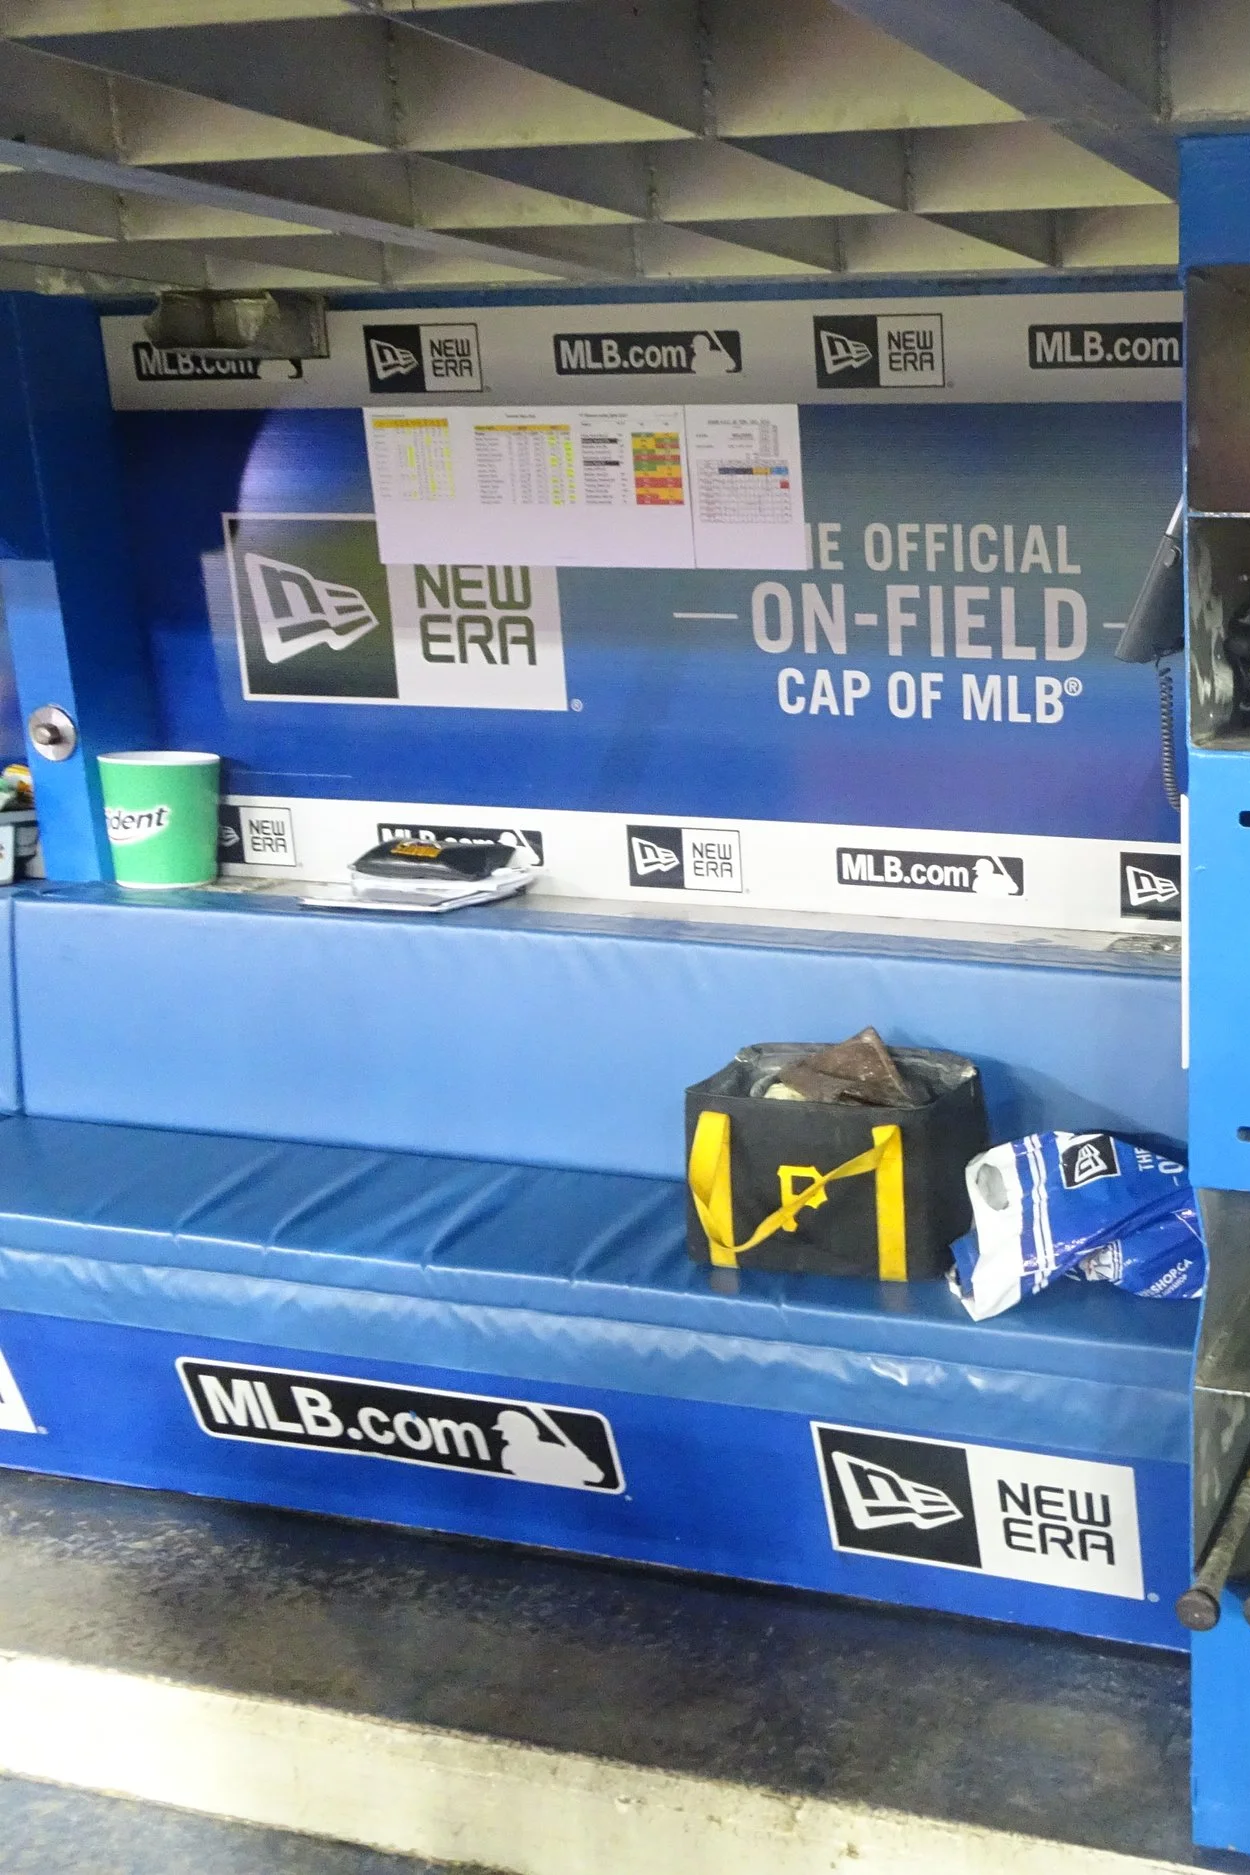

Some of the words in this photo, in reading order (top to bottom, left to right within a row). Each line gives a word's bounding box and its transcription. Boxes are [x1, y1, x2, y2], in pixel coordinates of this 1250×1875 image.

[429, 338, 471, 358] NEW
[559, 339, 688, 370] MLB.com
[887, 330, 933, 350] NEW
[1035, 330, 1180, 363] MLB.com
[432, 359, 473, 377] ERA
[889, 352, 934, 371] ERA
[864, 522, 1082, 574] OFFICIAL
[414, 564, 532, 611] NEW
[751, 580, 1088, 662] ON-FIELD
[419, 614, 537, 666] ERA
[777, 666, 871, 717] CAP
[887, 670, 944, 719] OF
[248, 819, 285, 836] NEW
[251, 837, 288, 853] ERA
[692, 842, 732, 860] NEW
[693, 860, 733, 878] ERA
[842, 853, 970, 887] MLB.com
[199, 1374, 491, 1461] MLB.com
[997, 1479, 1111, 1527] NEW
[1003, 1517, 1115, 1565] ERA
